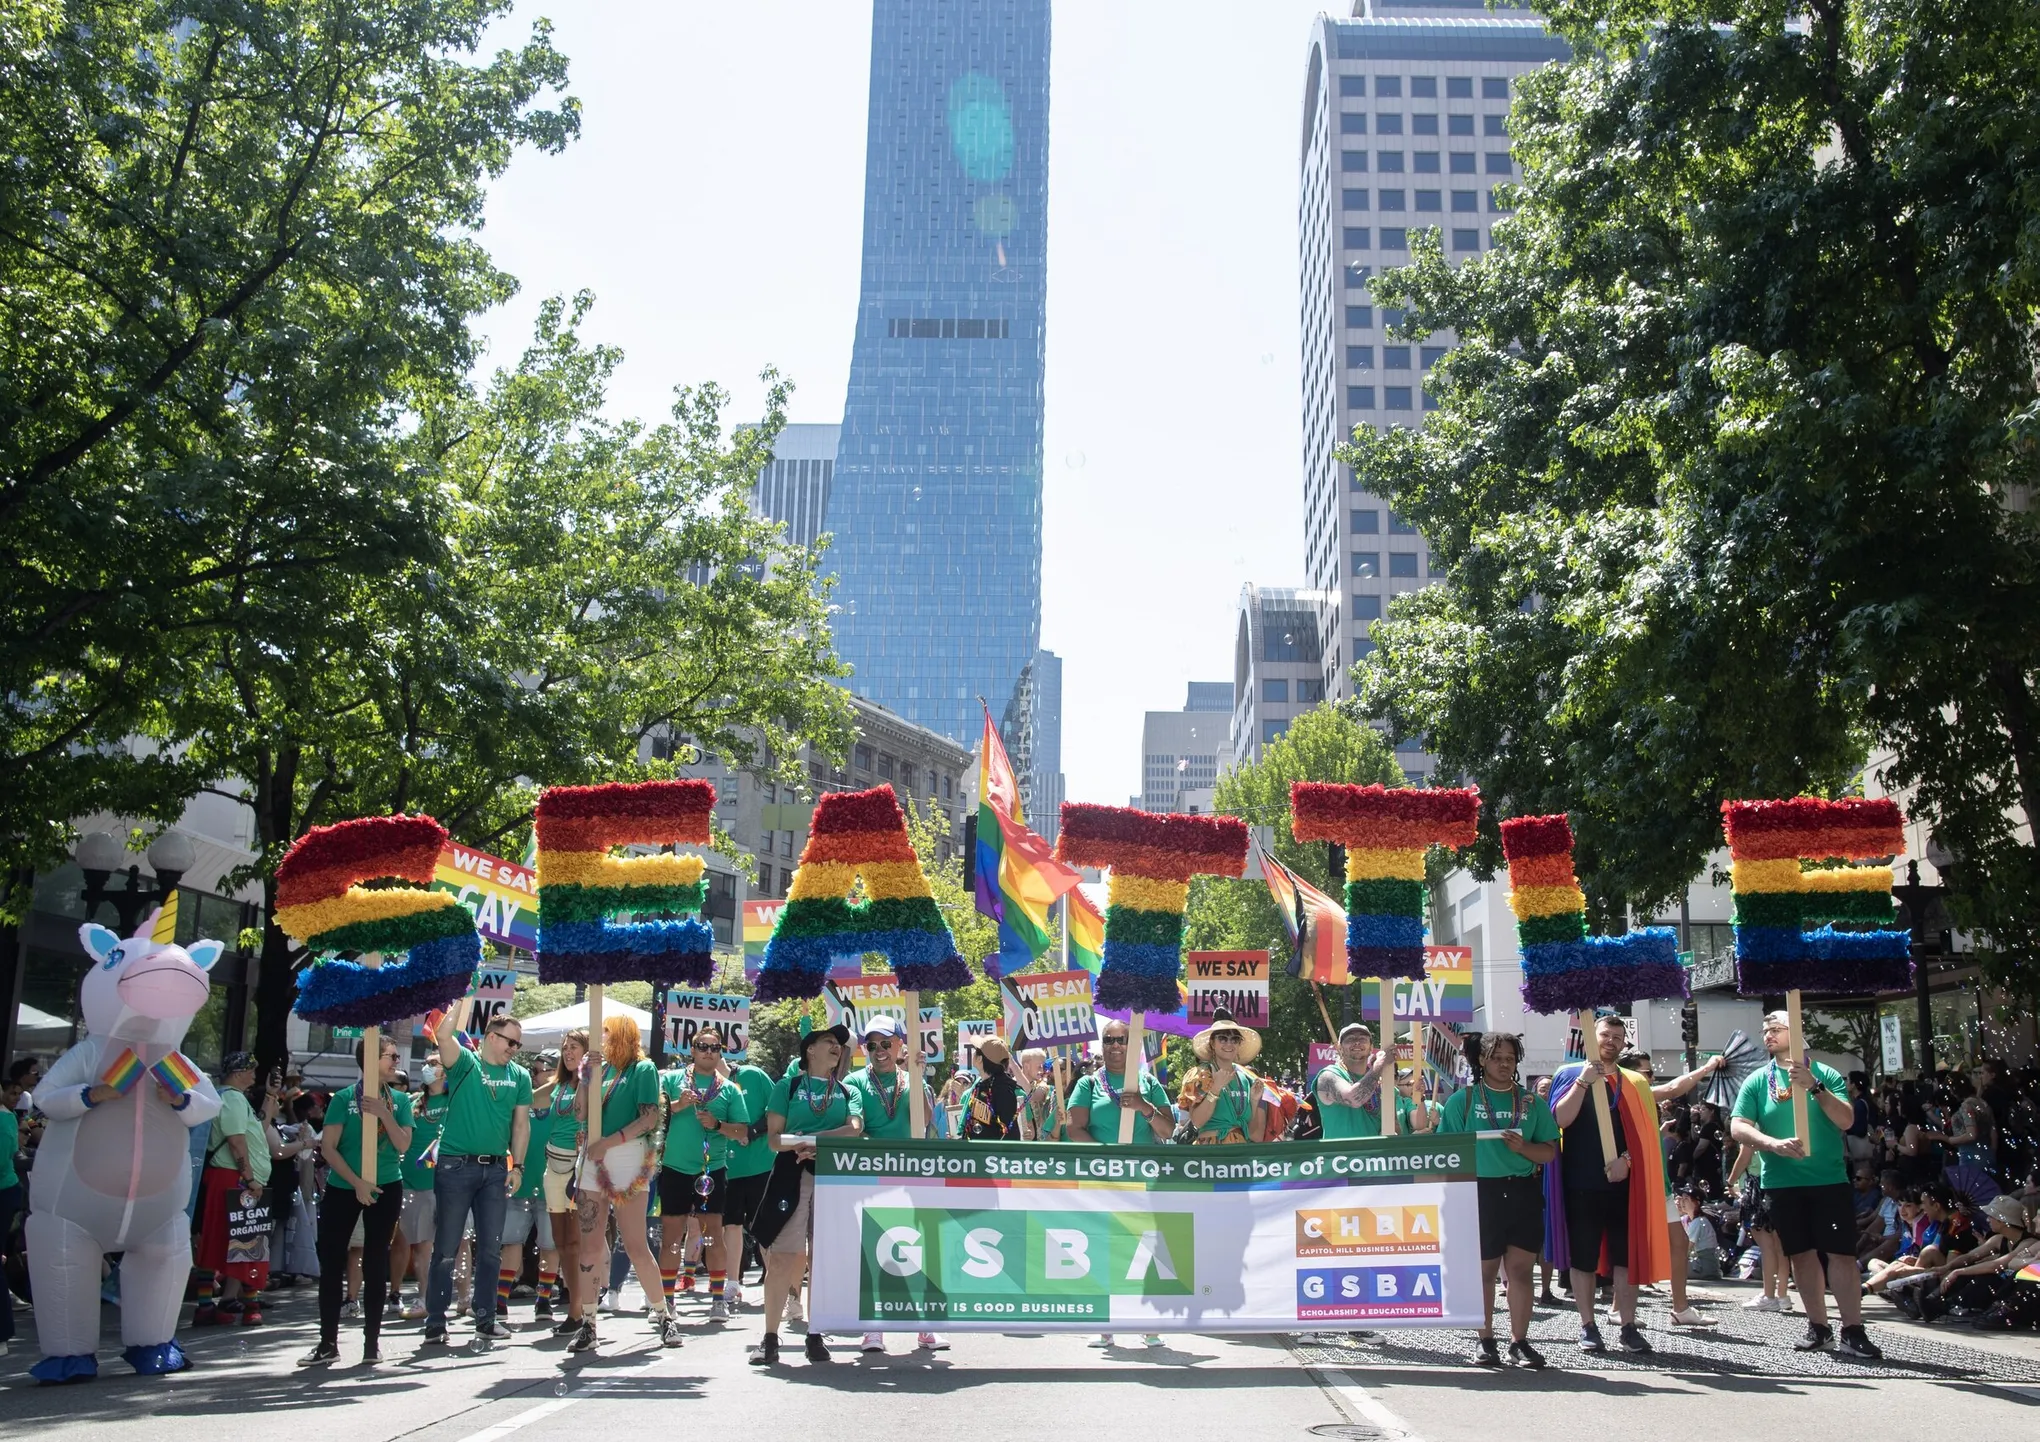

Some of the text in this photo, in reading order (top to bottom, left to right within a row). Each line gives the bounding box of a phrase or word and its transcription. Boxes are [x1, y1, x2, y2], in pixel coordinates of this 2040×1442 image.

[453, 848, 493, 879] WE
[1196, 960, 1259, 976] WE SAY
[480, 974, 507, 990] AY
[1016, 978, 1087, 1001] WE SAY
[836, 984, 865, 1001] WE
[1392, 977, 1447, 1017] GAY
[676, 995, 740, 1013] WE SAY
[967, 1024, 993, 1035] WE
[1022, 1002, 1095, 1041] QUEER
[1624, 1020, 1635, 1029] NE
[1885, 1022, 1895, 1033] NO
[336, 1028, 352, 1037] Pine
[671, 1018, 742, 1054] TRNS
[1888, 1057, 1897, 1066] RED
[1474, 1111, 1528, 1120] TOETHR
[832, 1152, 1461, 1179] Washington State's LGBTQ+ Chamber of Commerce
[229, 1206, 270, 1222] BE GAY
[230, 1222, 272, 1237] ORGANIZE
[1303, 1214, 1431, 1238] CHBA
[875, 1226, 1178, 1280] GSBA
[1299, 1247, 1334, 1255] CAPITOL
[1356, 1245, 1395, 1253] BUSINESS
[1397, 1244, 1437, 1252] ALLIANCE
[1302, 1273, 1436, 1299] GSBA
[874, 1301, 1094, 1313] EQUALITY IS GOOD BUSINESS
[1301, 1309, 1359, 1317] SCHOLARSHIP
[1368, 1307, 1415, 1315] EDUCATION
[1417, 1306, 1440, 1314] FUND
